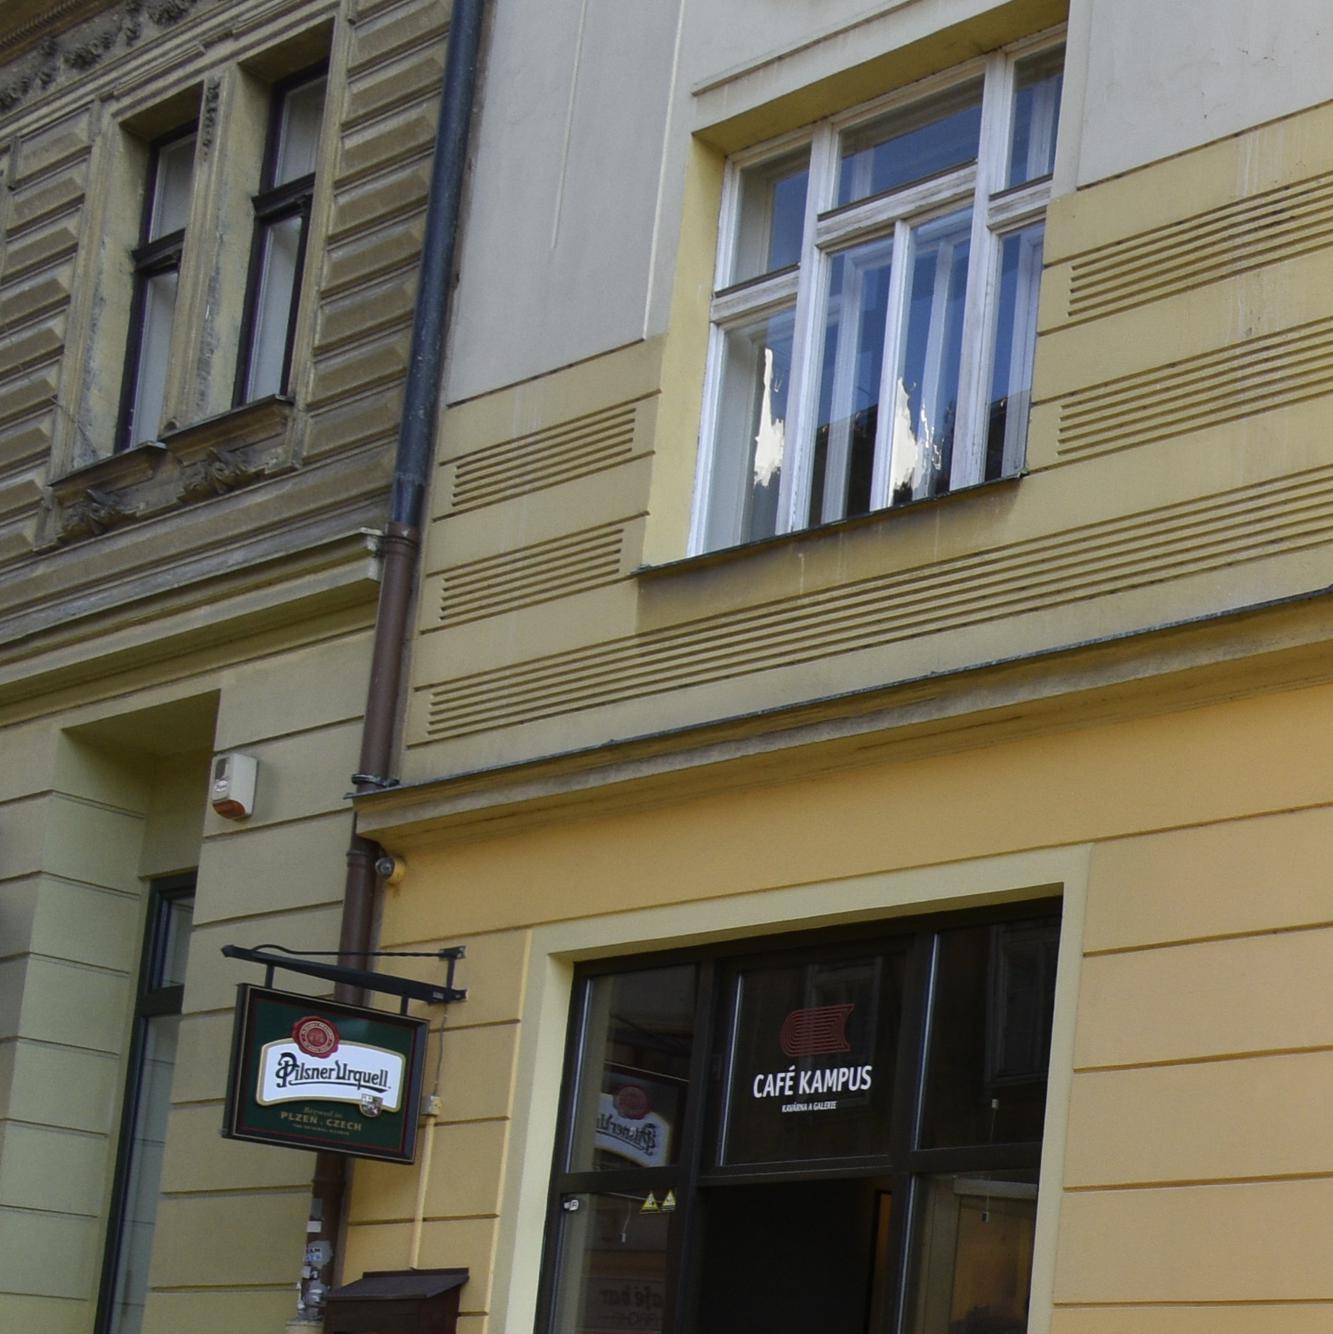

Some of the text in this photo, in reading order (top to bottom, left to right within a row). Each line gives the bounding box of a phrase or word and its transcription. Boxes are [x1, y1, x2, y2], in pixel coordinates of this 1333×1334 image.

[275, 1052, 388, 1091] Pilsner Urquell
[753, 1064, 873, 1098] CAFÉ KAMPUS
[813, 1101, 838, 1111] GALERIE
[326, 1118, 363, 1131] CZECH
